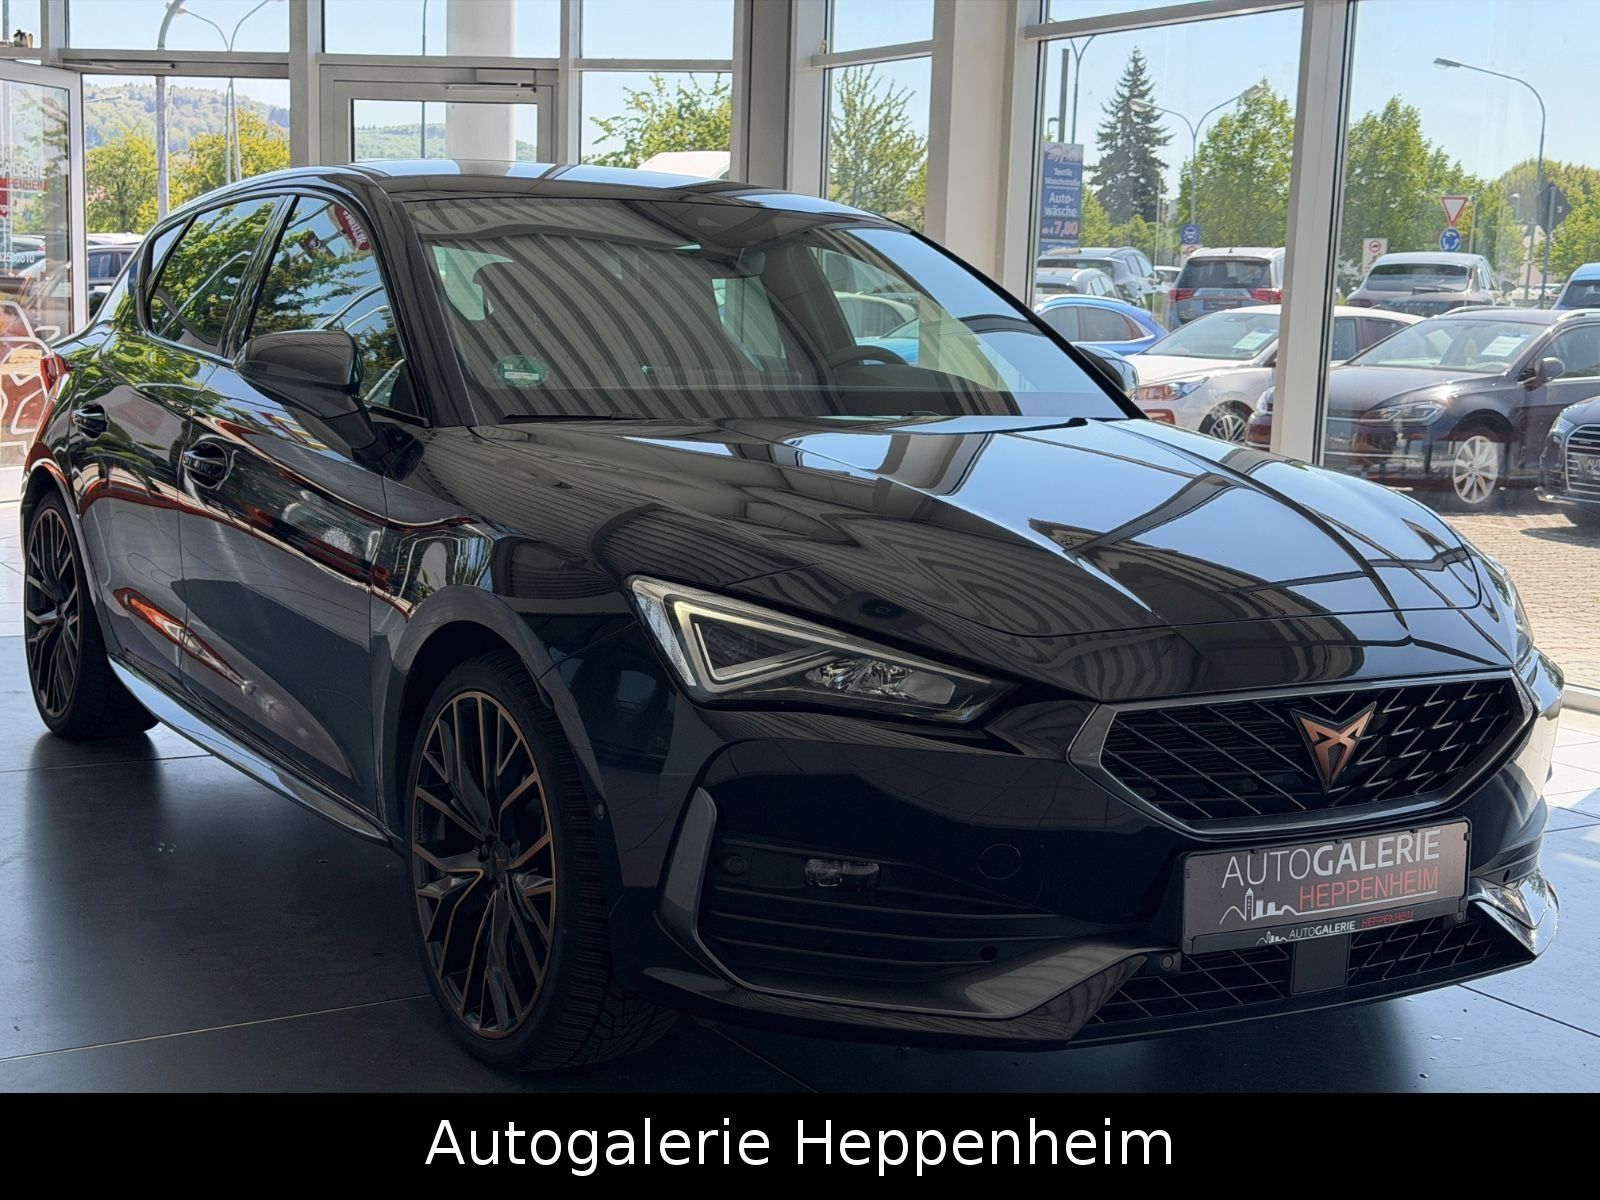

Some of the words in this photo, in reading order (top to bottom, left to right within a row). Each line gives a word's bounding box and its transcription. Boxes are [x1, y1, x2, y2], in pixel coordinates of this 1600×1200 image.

[1044, 205, 1077, 217] wäsche
[1049, 192, 1075, 204] Auto-
[1221, 829, 1441, 889] AUTOGALERIE
[1299, 864, 1439, 911] HEPPENHEIM
[1288, 920, 1356, 940] AUTOGALERIE
[1361, 909, 1415, 928] HEPPENHEIM
